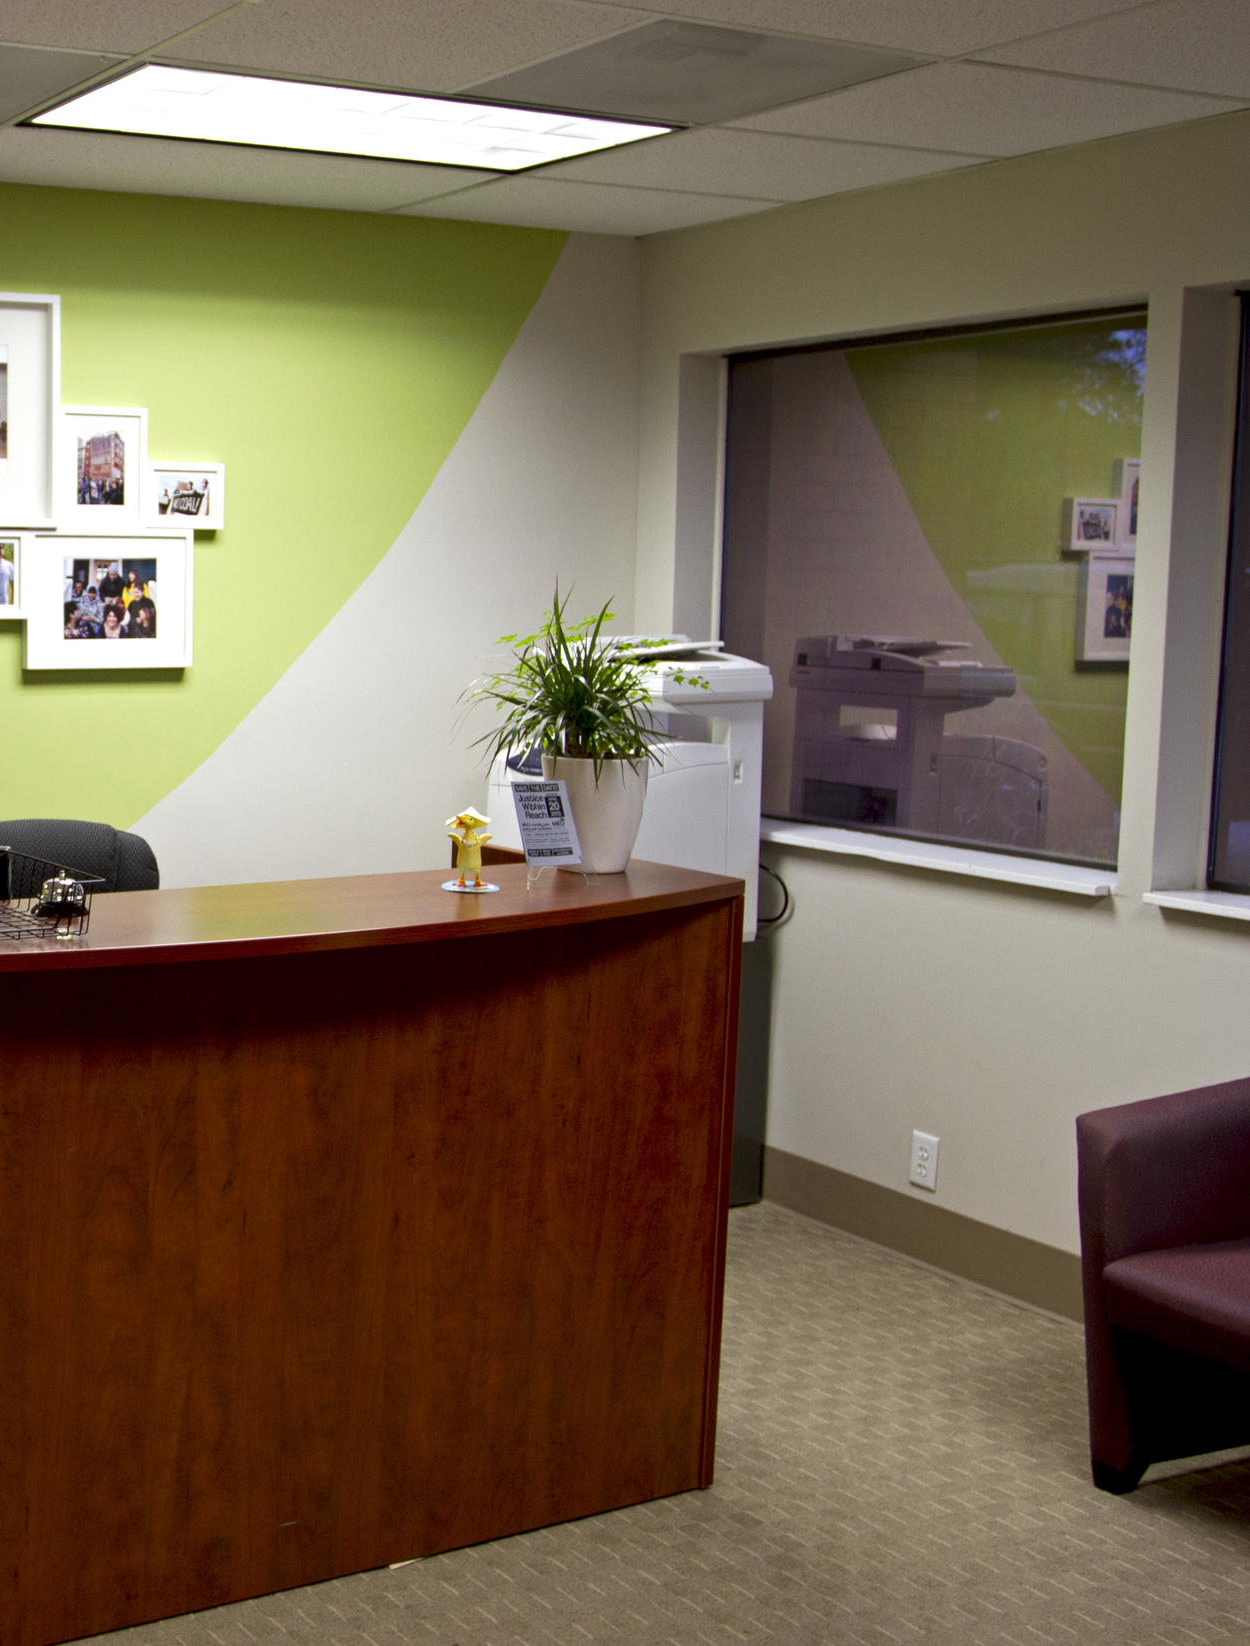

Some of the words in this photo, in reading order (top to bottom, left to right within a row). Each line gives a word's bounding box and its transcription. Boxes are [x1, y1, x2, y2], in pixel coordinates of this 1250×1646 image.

[530, 784, 541, 792] THE
[518, 794, 544, 803] Justice
[522, 802, 546, 811] Within
[548, 802, 560, 811] 20
[525, 811, 548, 819] Reach
